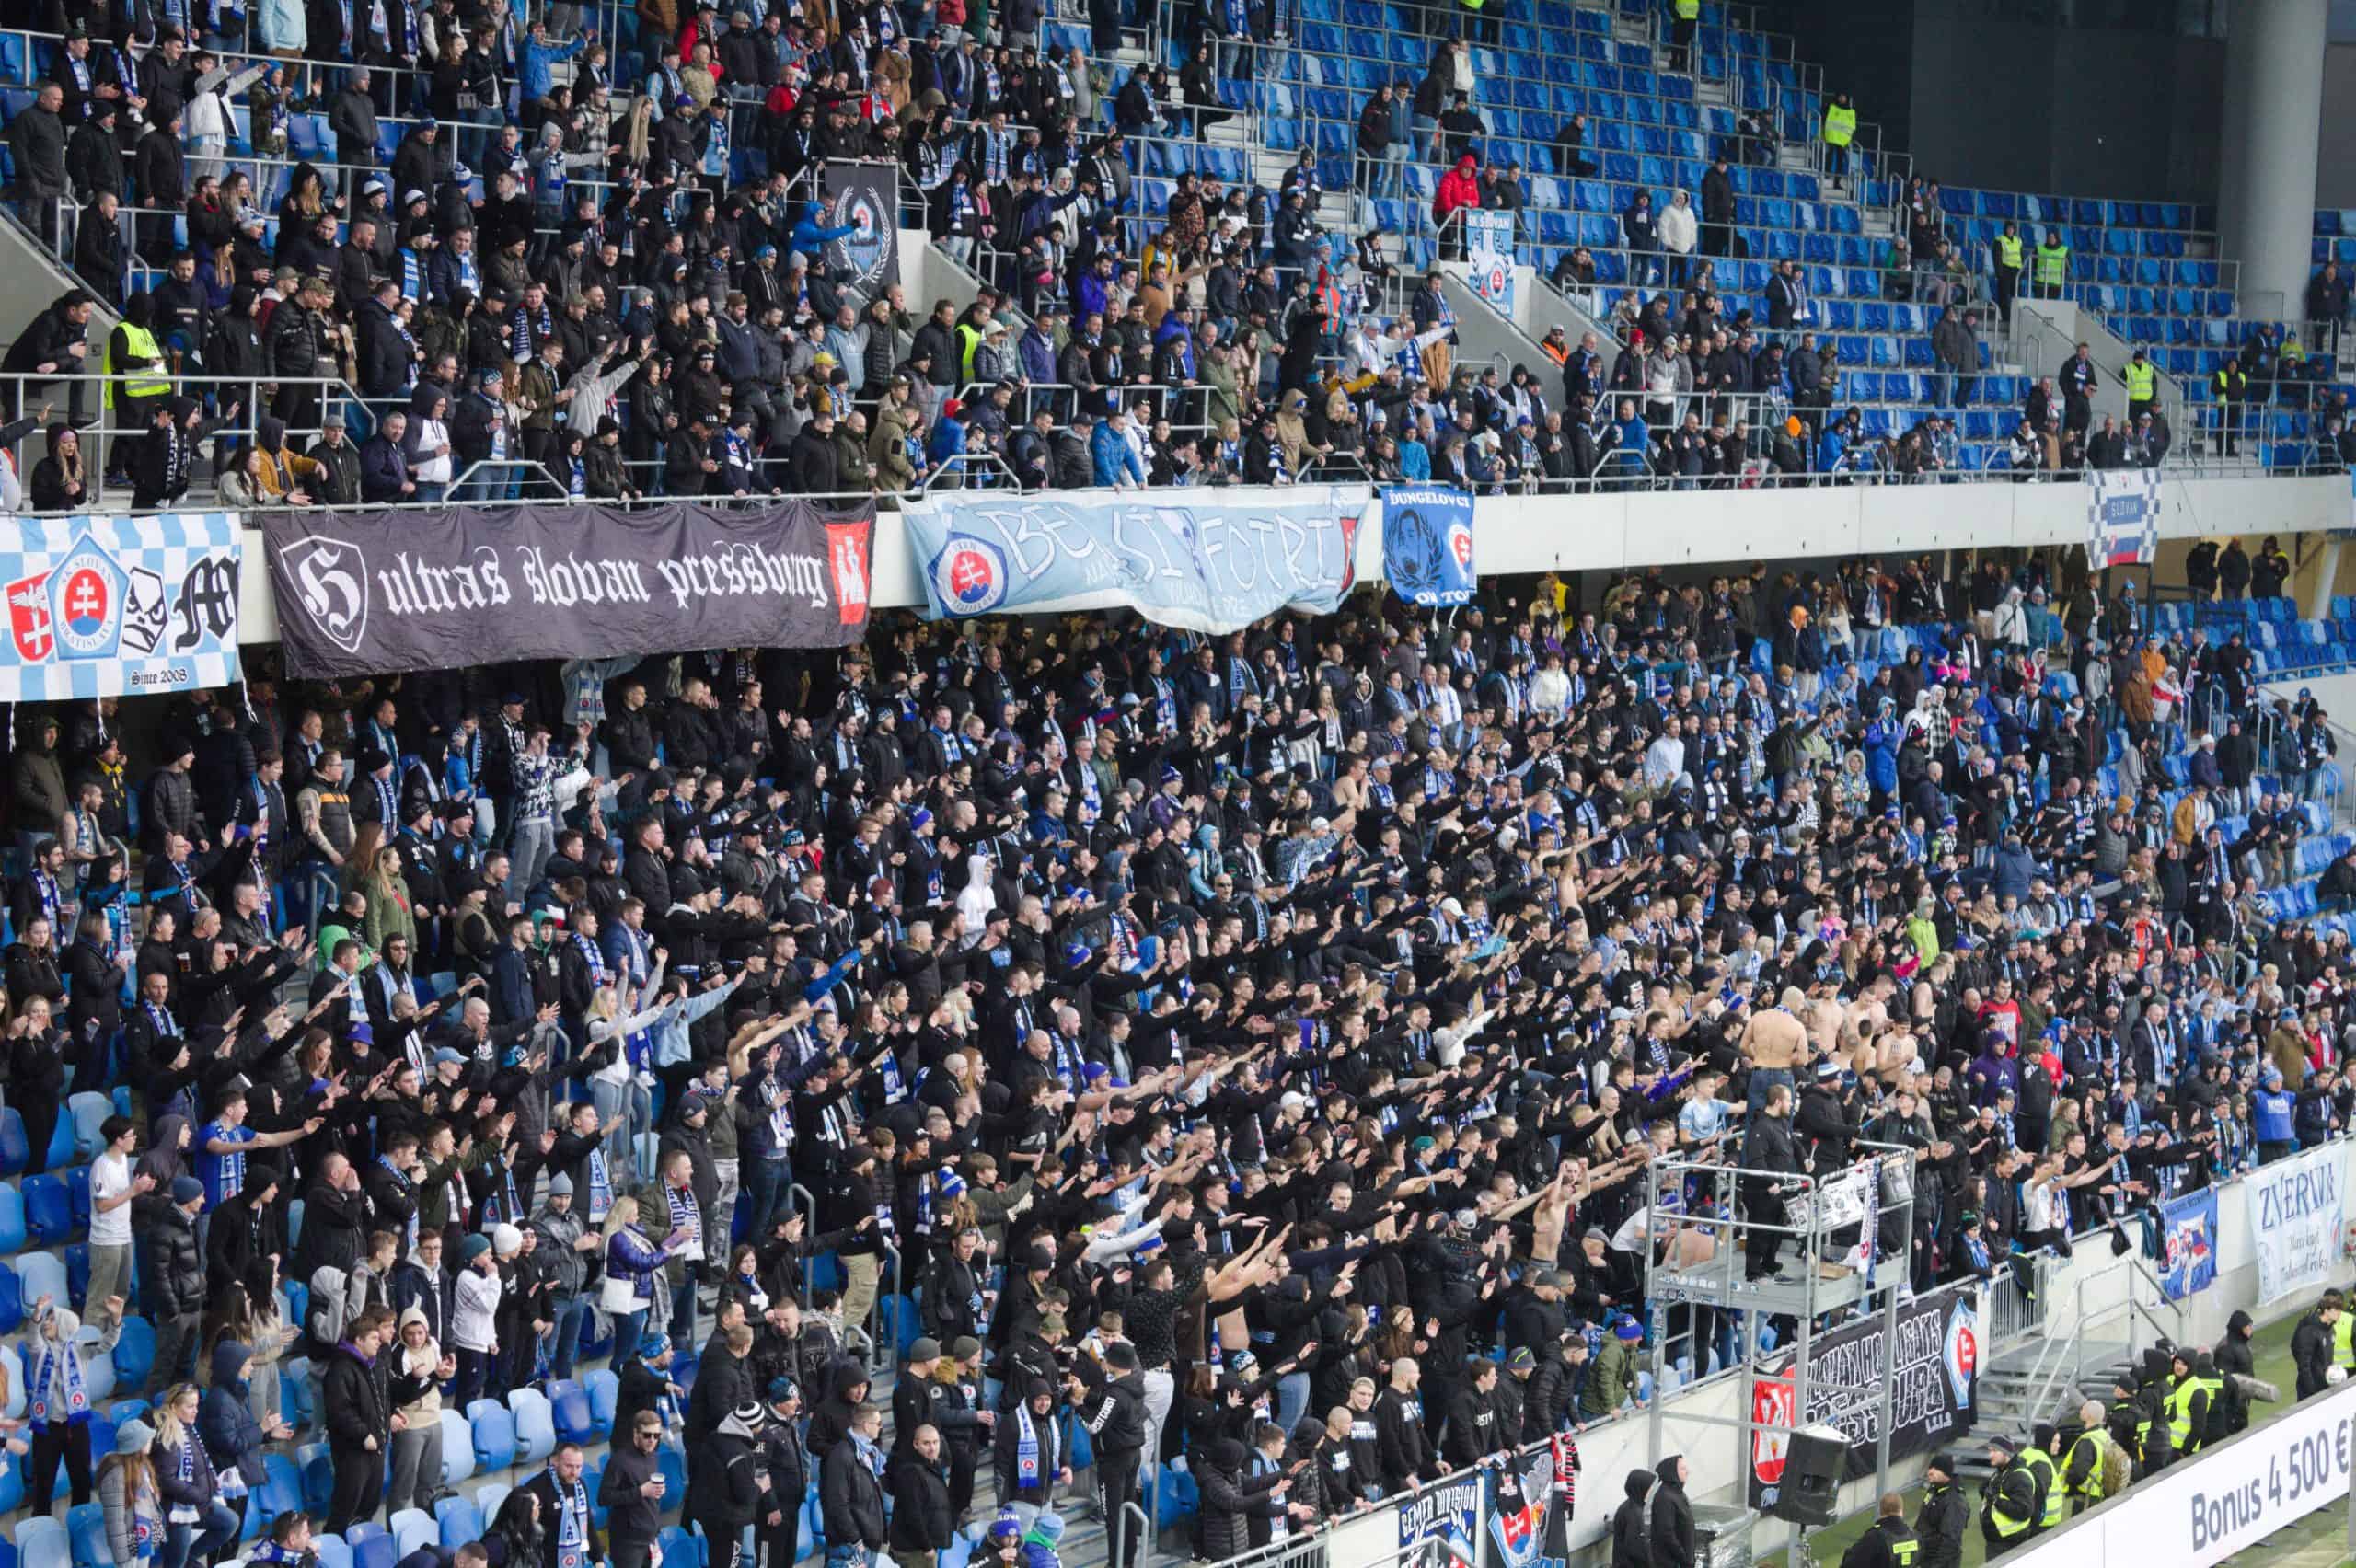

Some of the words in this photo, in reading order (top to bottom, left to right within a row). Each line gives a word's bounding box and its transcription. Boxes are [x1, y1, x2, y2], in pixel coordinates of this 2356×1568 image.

[2111, 501, 2137, 516] SLOVAN
[131, 671, 157, 686] Since
[160, 669, 188, 684] 2008
[2191, 1479, 2261, 1552] Bonus
[2269, 1455, 2281, 1506] 4
[2289, 1429, 2329, 1501] 500
[2335, 1418, 2350, 1473] €
[1435, 1484, 1477, 1516] DIVISION
